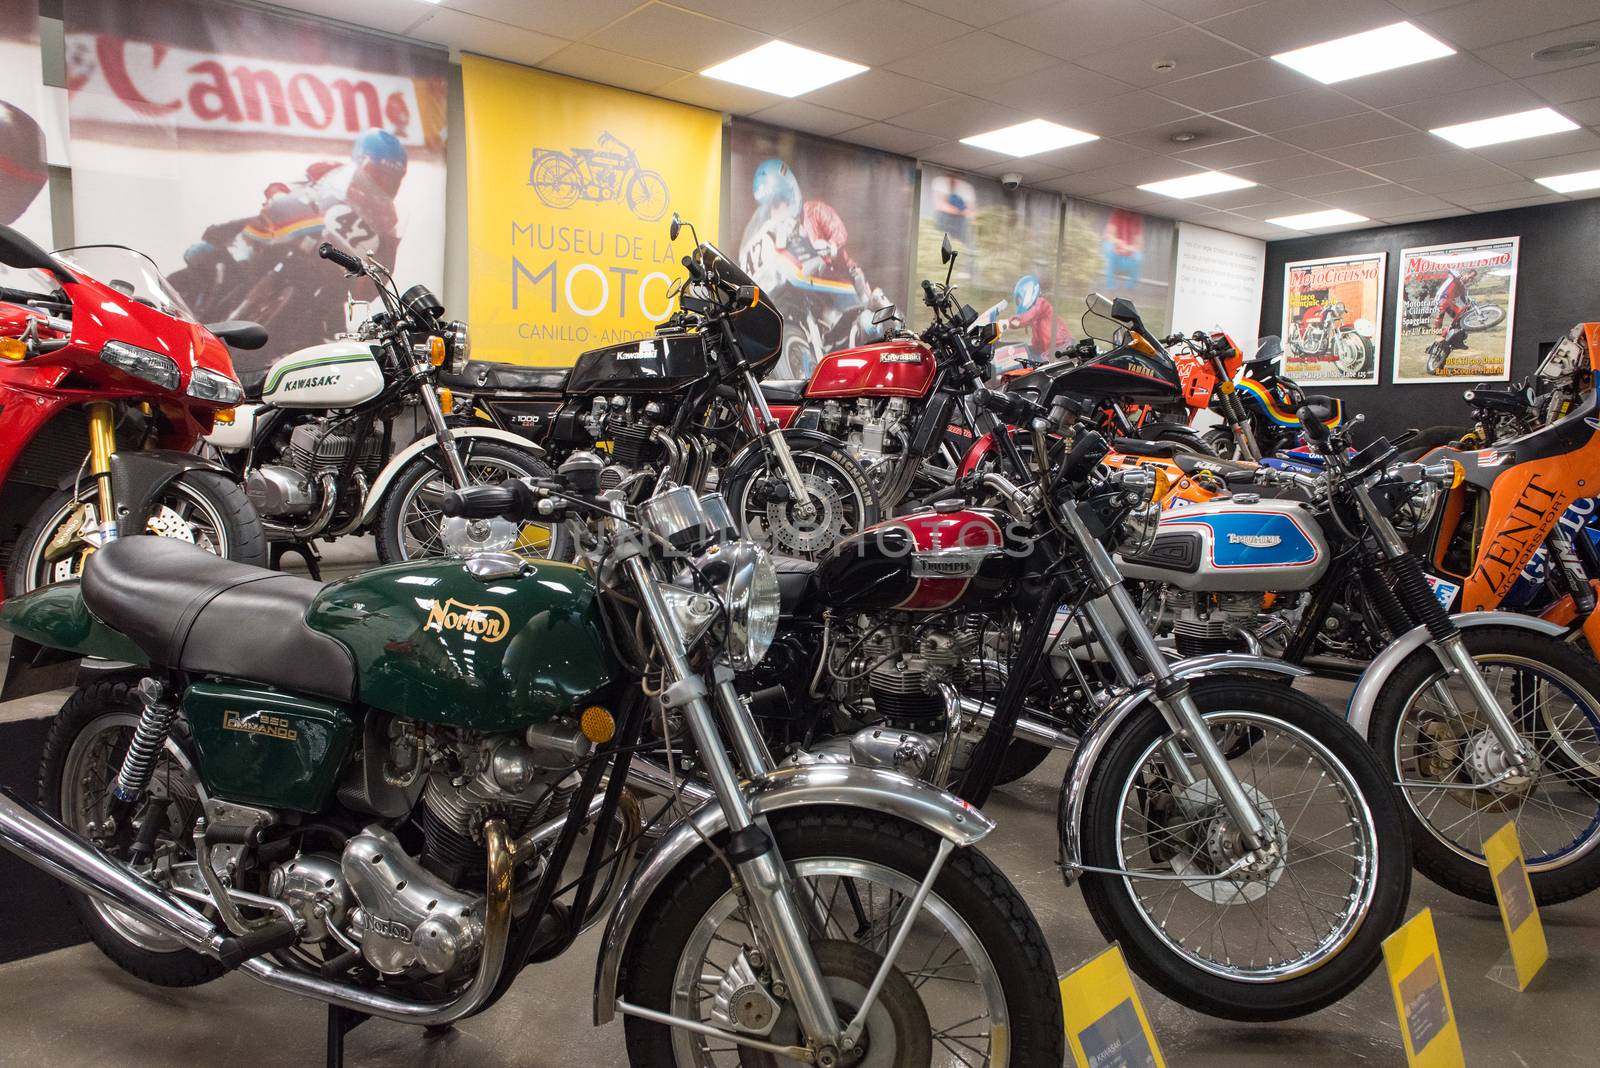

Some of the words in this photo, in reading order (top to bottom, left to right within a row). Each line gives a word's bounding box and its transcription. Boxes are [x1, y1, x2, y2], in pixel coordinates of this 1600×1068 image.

[511, 220, 604, 256] MUSEU
[615, 234, 644, 260] DE
[653, 240, 676, 264] LA
[512, 255, 675, 322] MOTO
[518, 323, 589, 342] CANILLO
[880, 353, 921, 363] Kawasaki
[1127, 362, 1155, 377] YAMAHA
[518, 415, 540, 423] 1000
[1472, 473, 1560, 595] ZENIT
[1497, 489, 1567, 598] MOTORSPORT
[919, 560, 972, 575] TRIUMPH
[423, 597, 510, 643] Norton
[363, 913, 412, 945] Norton
